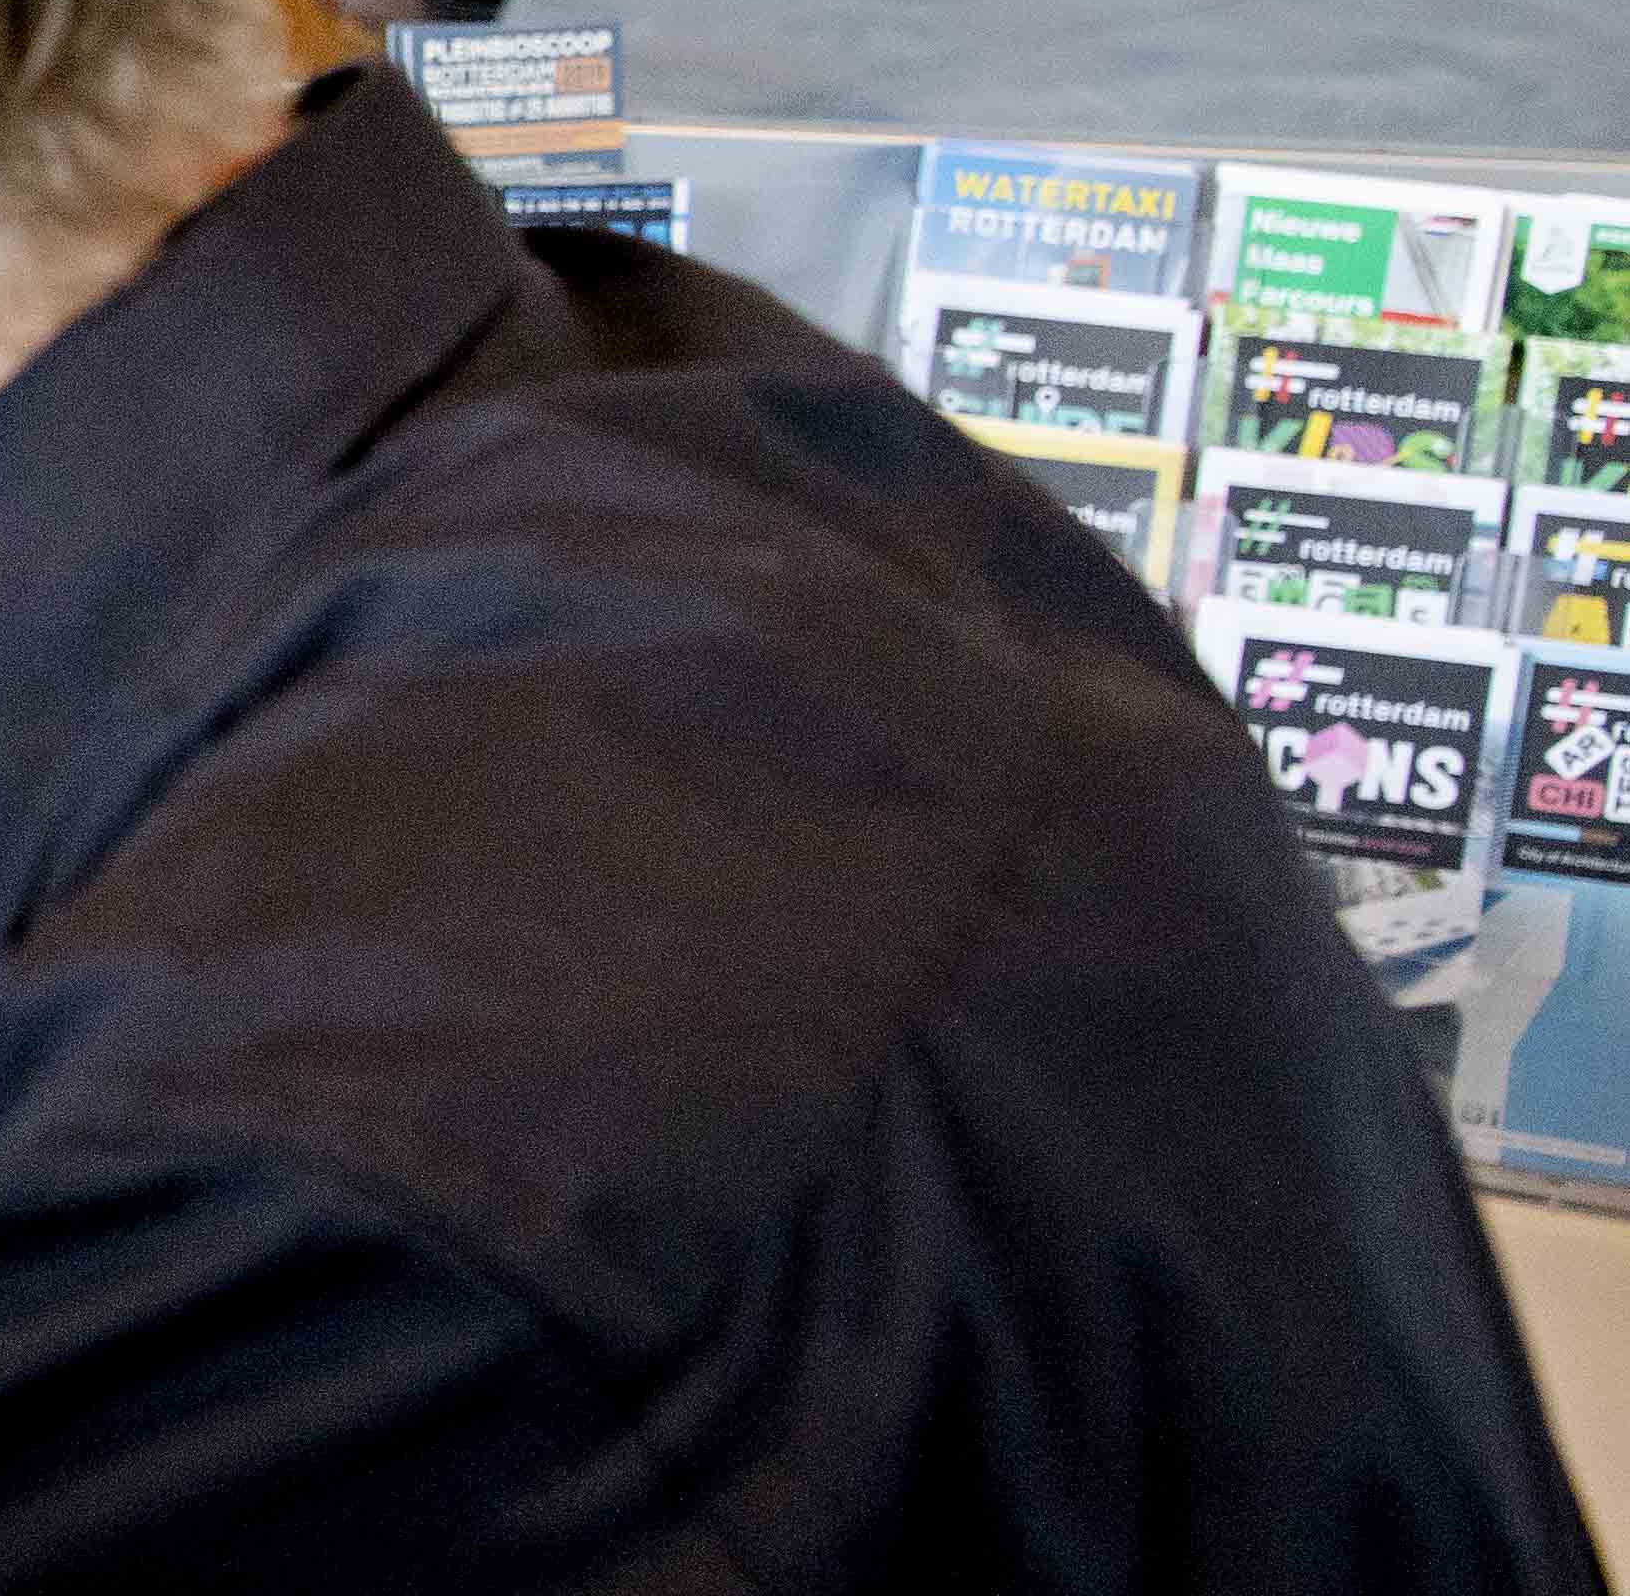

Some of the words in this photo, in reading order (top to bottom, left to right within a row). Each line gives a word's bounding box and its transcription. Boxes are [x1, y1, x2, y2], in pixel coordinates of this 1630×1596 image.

[423, 30, 614, 62] PLEINBIOSCOOP
[423, 60, 555, 89] ROTTERDAM
[955, 171, 1176, 220] WATERTAXI
[948, 207, 1169, 254] ROTTERDAM
[1251, 209, 1362, 243] Nieuwe
[1240, 280, 1375, 316] Parcours
[1004, 357, 1154, 395] rotterdam
[1307, 386, 1462, 423] rotterdam
[1297, 538, 1454, 576] rotterdam
[1313, 690, 1472, 732] rotterdam
